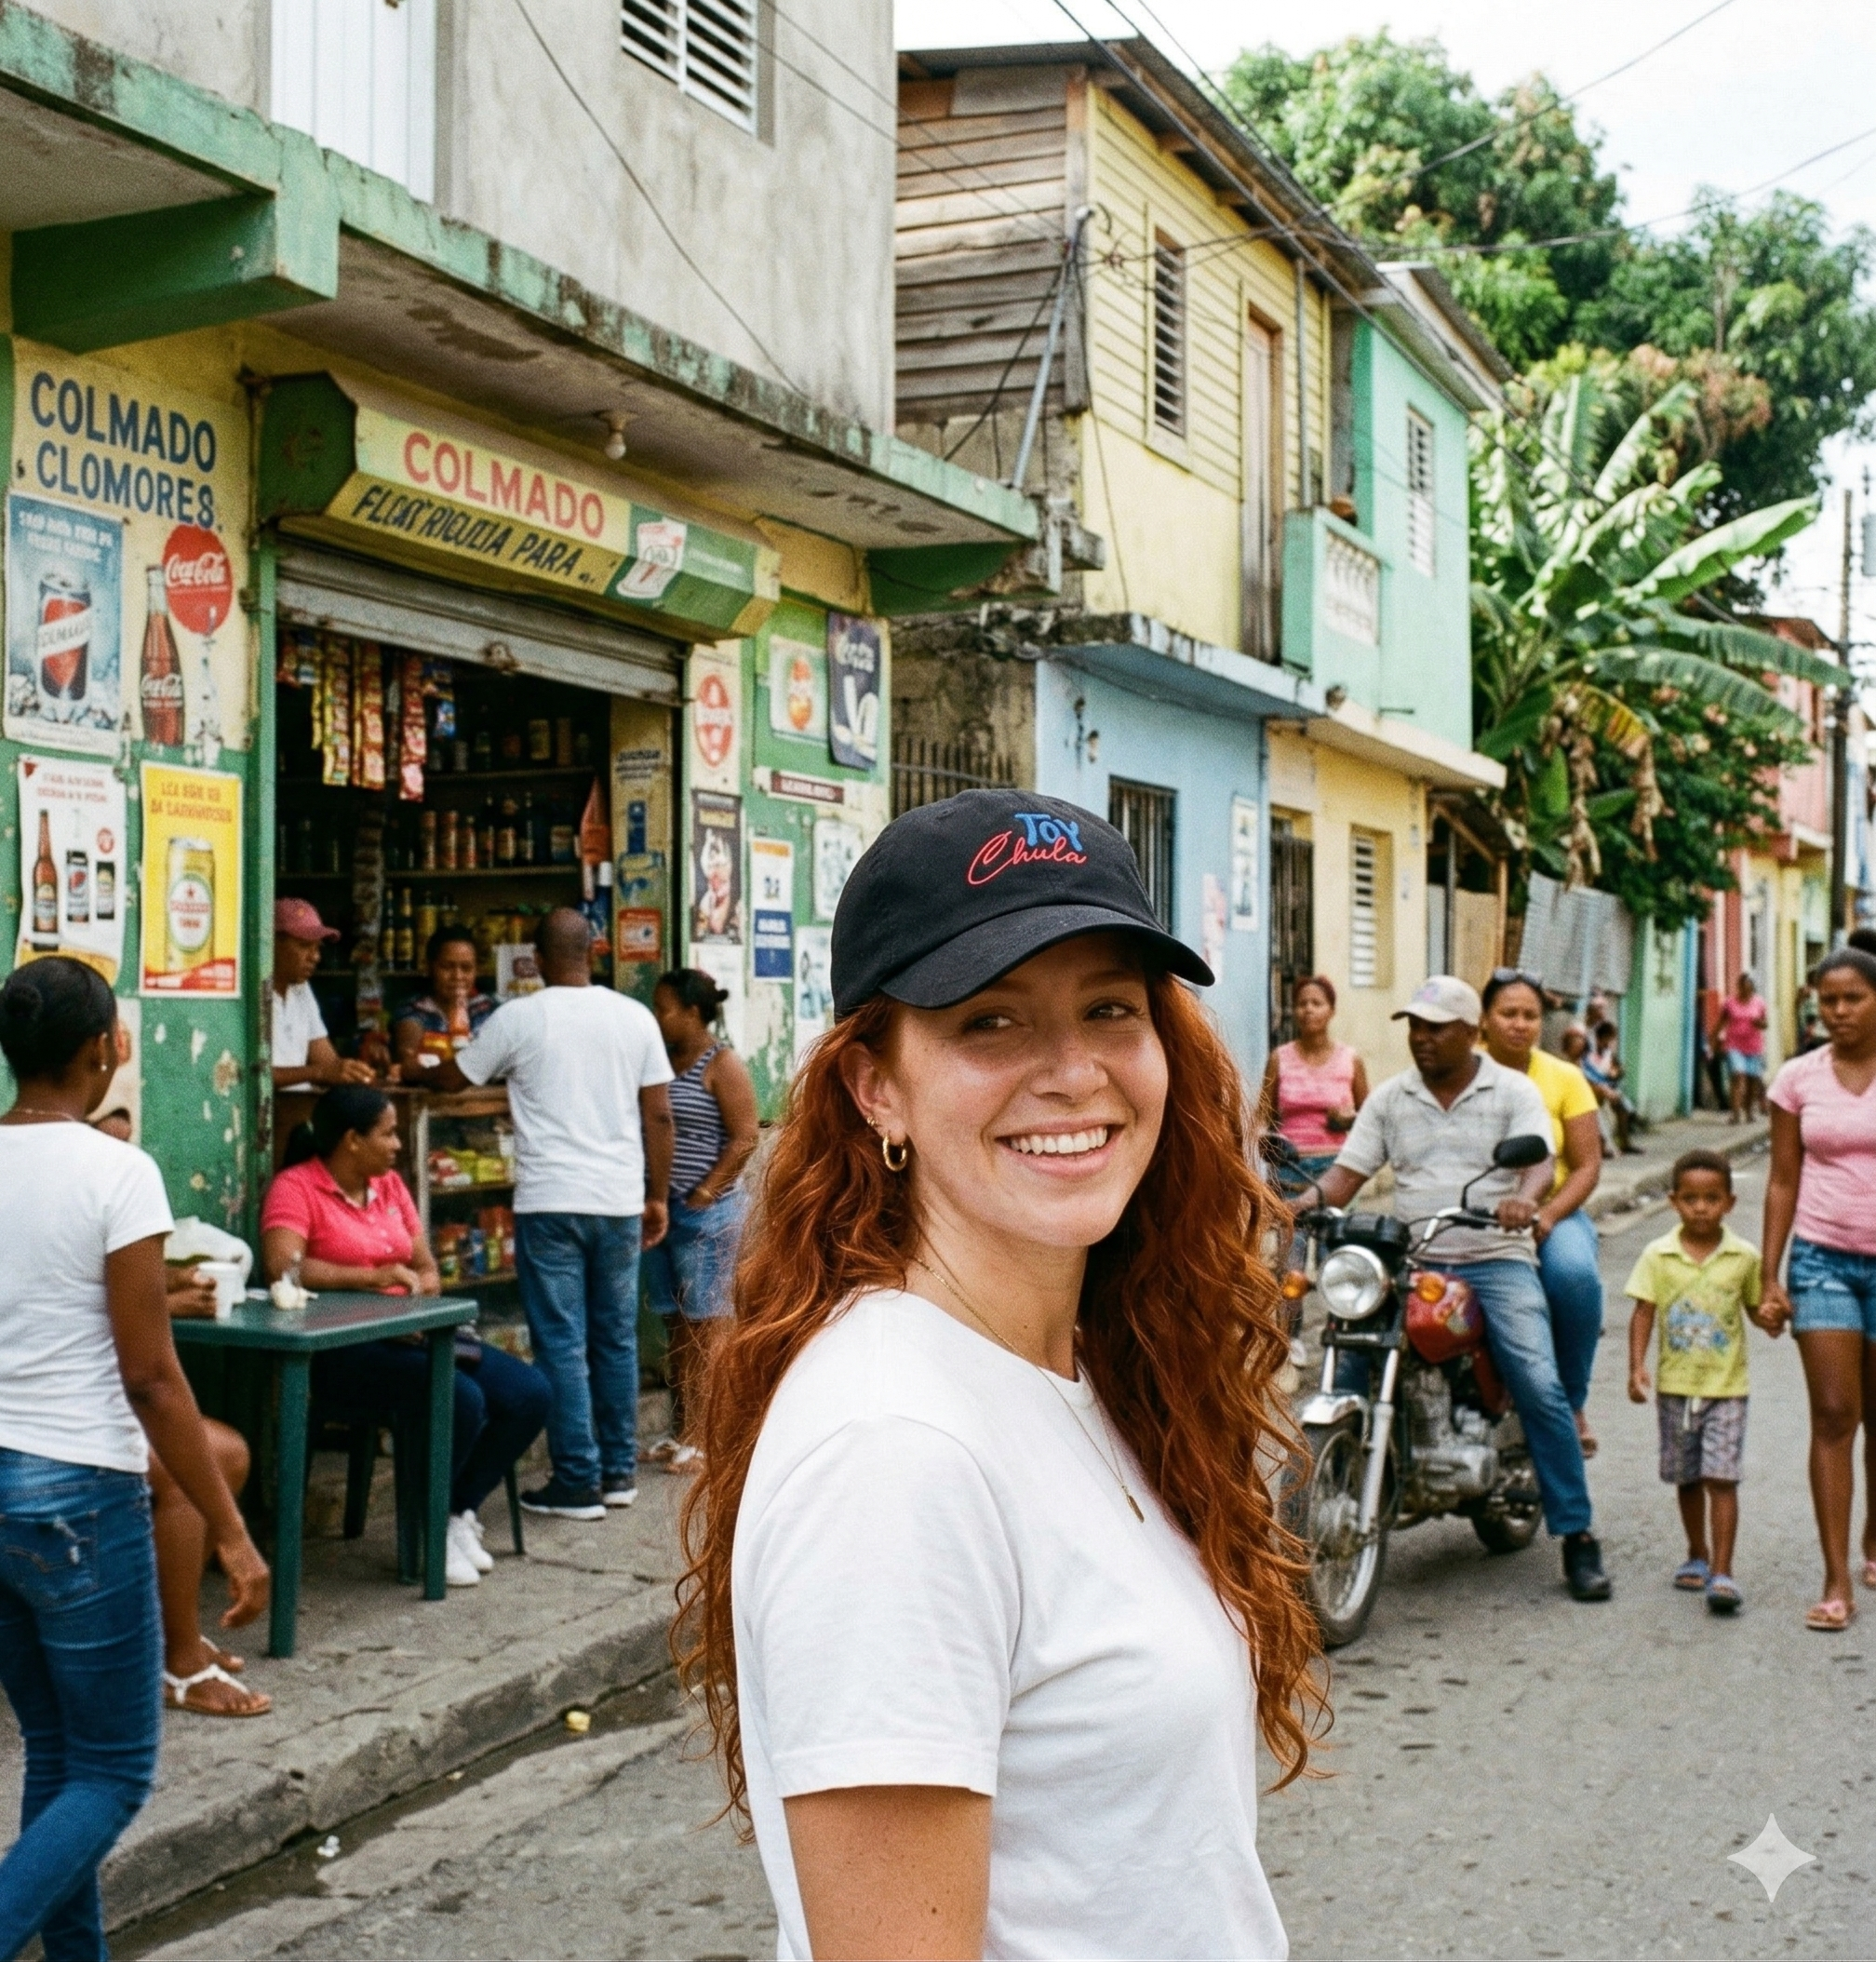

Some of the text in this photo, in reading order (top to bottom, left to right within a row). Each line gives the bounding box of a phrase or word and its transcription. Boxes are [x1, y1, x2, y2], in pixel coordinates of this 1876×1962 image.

[31, 370, 217, 473] COLMADO
[403, 431, 605, 539] COLMADO
[510, 531, 583, 576] PARA
[967, 830, 1088, 885] Chula
